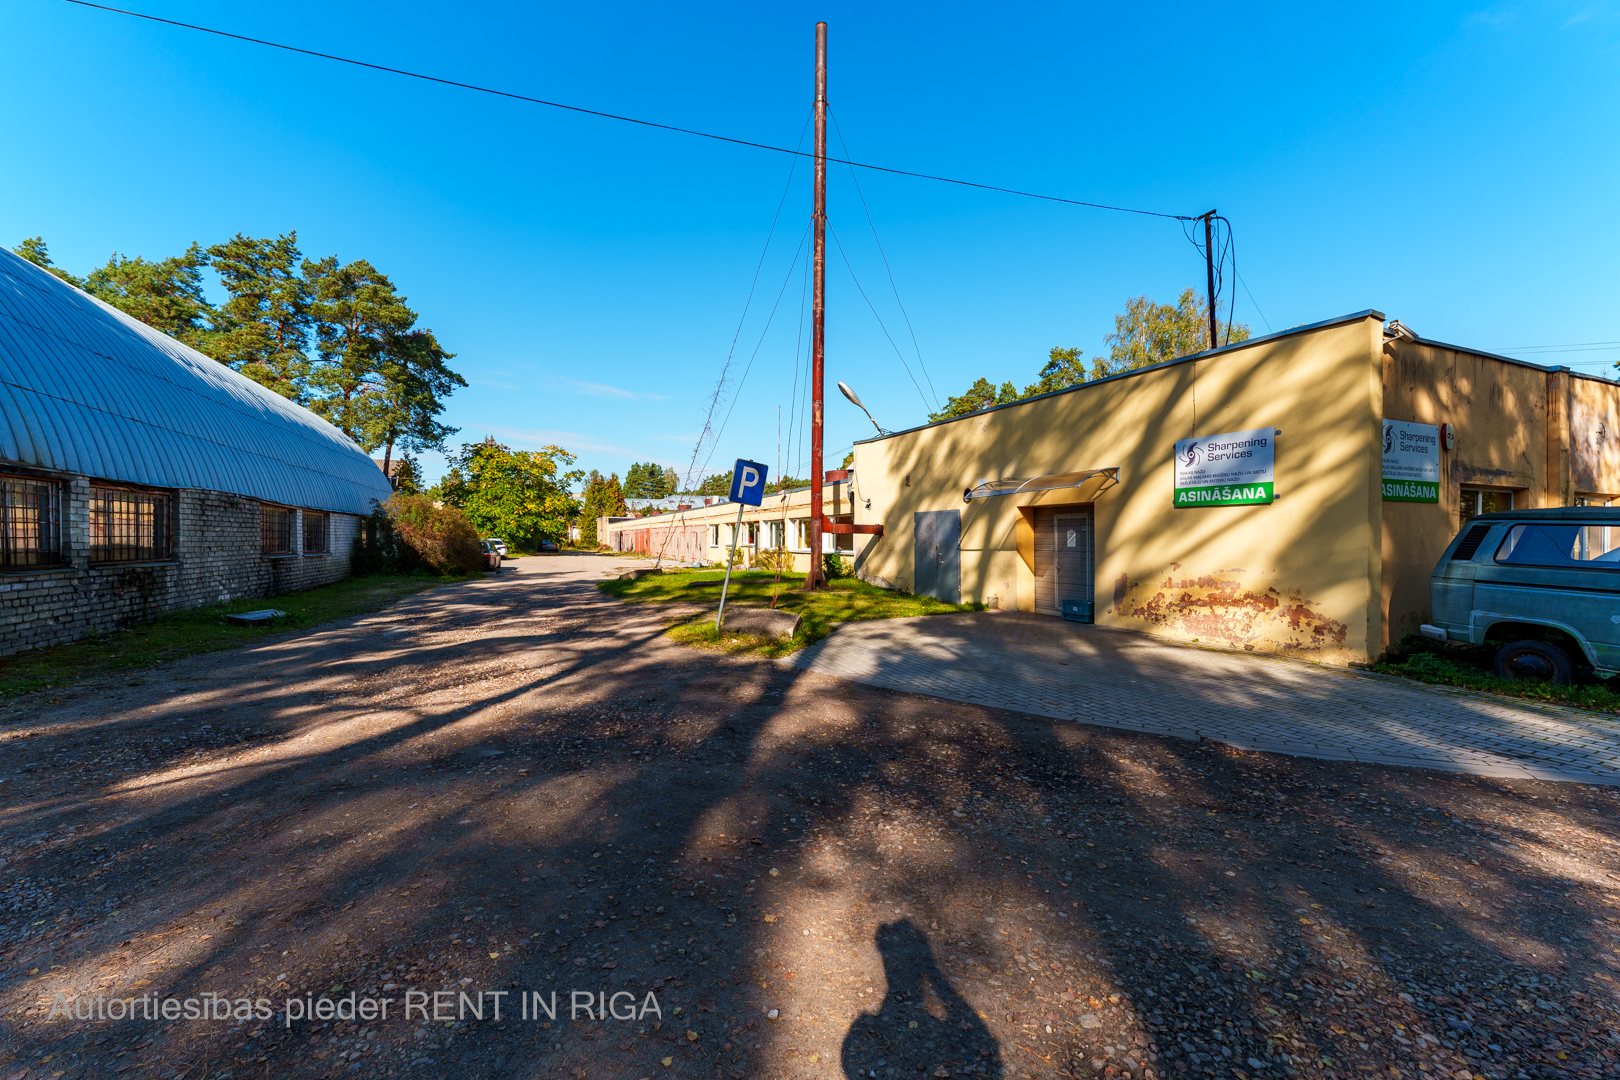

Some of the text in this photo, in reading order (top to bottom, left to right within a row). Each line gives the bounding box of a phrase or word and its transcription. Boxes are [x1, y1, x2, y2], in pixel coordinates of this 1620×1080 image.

[1400, 430, 1436, 445] Sharpening
[1208, 438, 1267, 452] Sharpening
[1400, 442, 1428, 453] Services
[1208, 451, 1252, 461] Services
[738, 466, 759, 498] P
[1178, 487, 1266, 502] ASINĀŠANA
